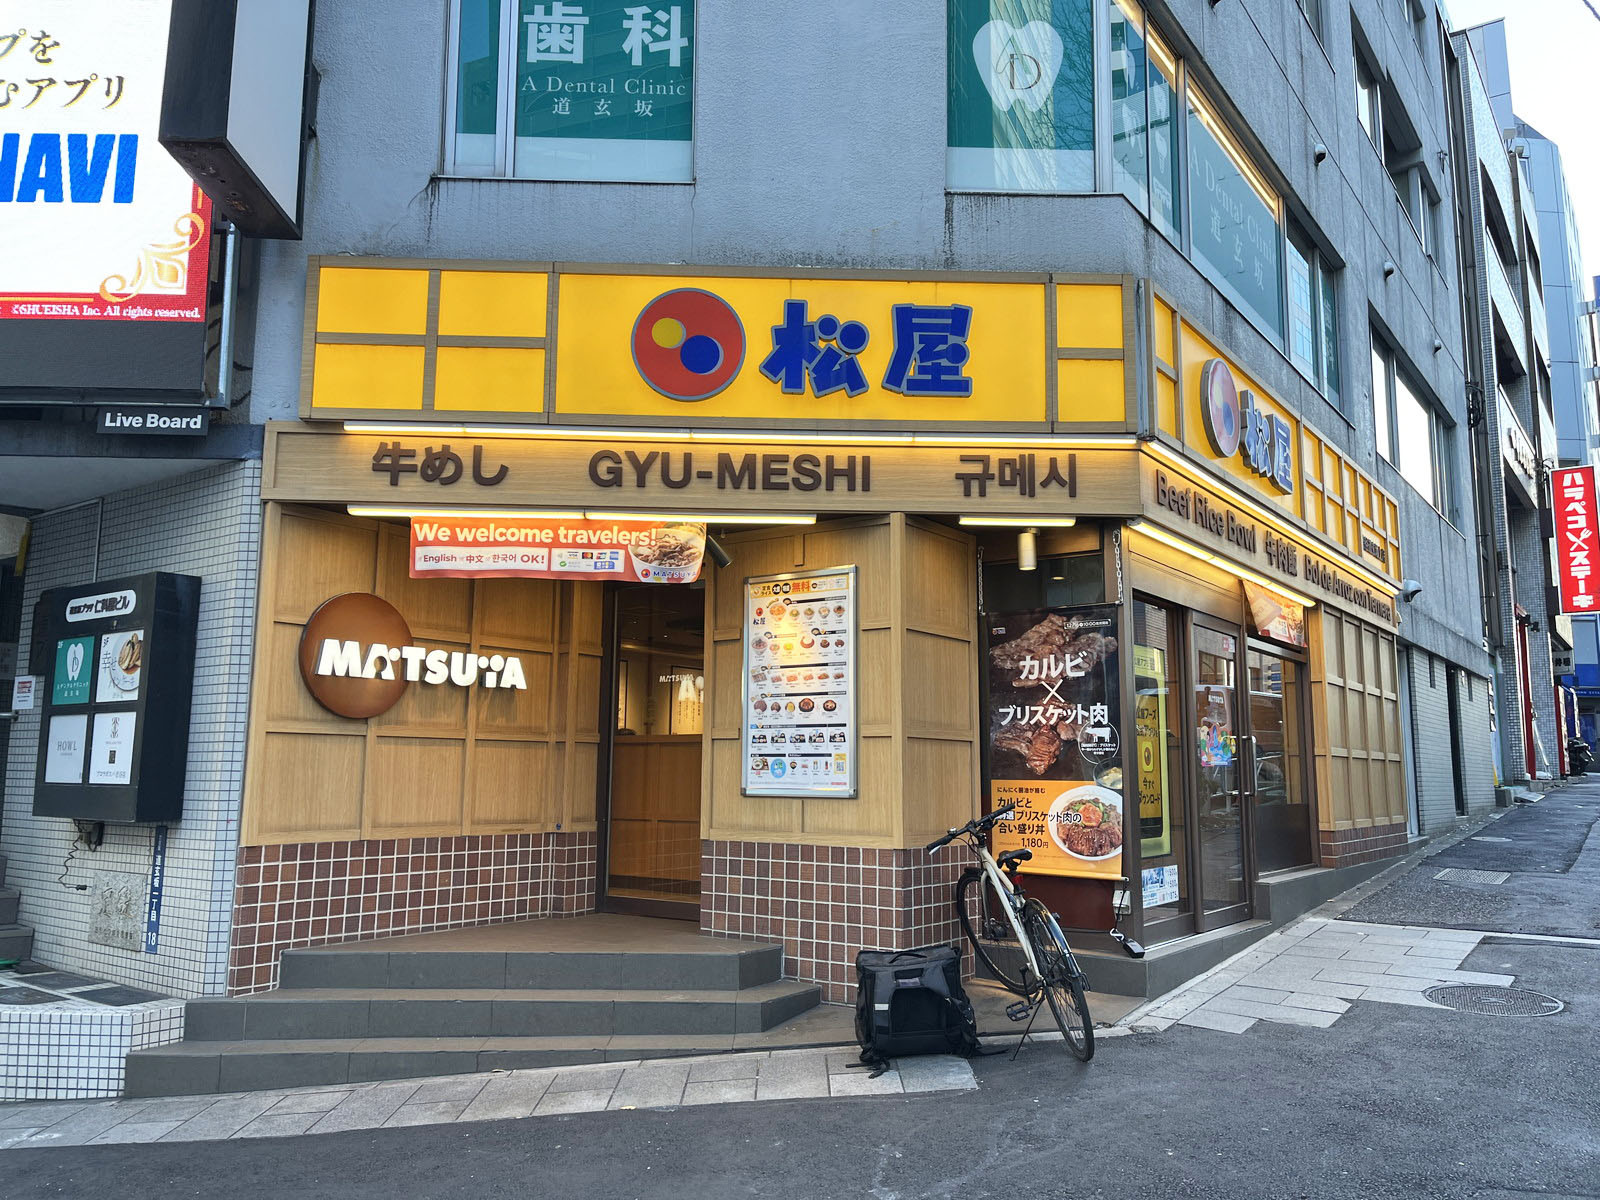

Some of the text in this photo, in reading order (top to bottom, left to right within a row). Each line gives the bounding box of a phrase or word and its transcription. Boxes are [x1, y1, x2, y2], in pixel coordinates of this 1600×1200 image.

[522, 1, 689, 67] 歯科
[522, 76, 687, 97] A Dental Clinic
[552, 97, 654, 117] 道玄坂
[104, 305, 120, 317] All
[122, 306, 153, 319] rights
[154, 307, 201, 318] reserved.
[759, 299, 973, 398] 松屋
[104, 412, 202, 429] Live Board
[1240, 390, 1294, 495] 松屋
[372, 441, 509, 486] 牛めし
[588, 449, 872, 492] GYU-MESHI
[954, 453, 1077, 498] 규메시
[1156, 469, 1257, 554] Beef Rice Bowl
[1562, 471, 1587, 529] ハラペコ
[414, 523, 657, 546] We welcome travelers!
[423, 553, 457, 564] English
[465, 554, 484, 564] 中文
[492, 553, 517, 564] 한국어
[520, 554, 545, 564] OK!
[1304, 553, 1392, 621] Bol de Arroz con Ternera
[1569, 551, 1594, 608] ステーキ
[1019, 651, 1088, 680] カルビ
[999, 702, 1109, 726] ブリスケット肉
[56, 740, 78, 751] HOWL
[998, 822, 1046, 836] 合い盛り丼
[147, 931, 157, 946] 18
